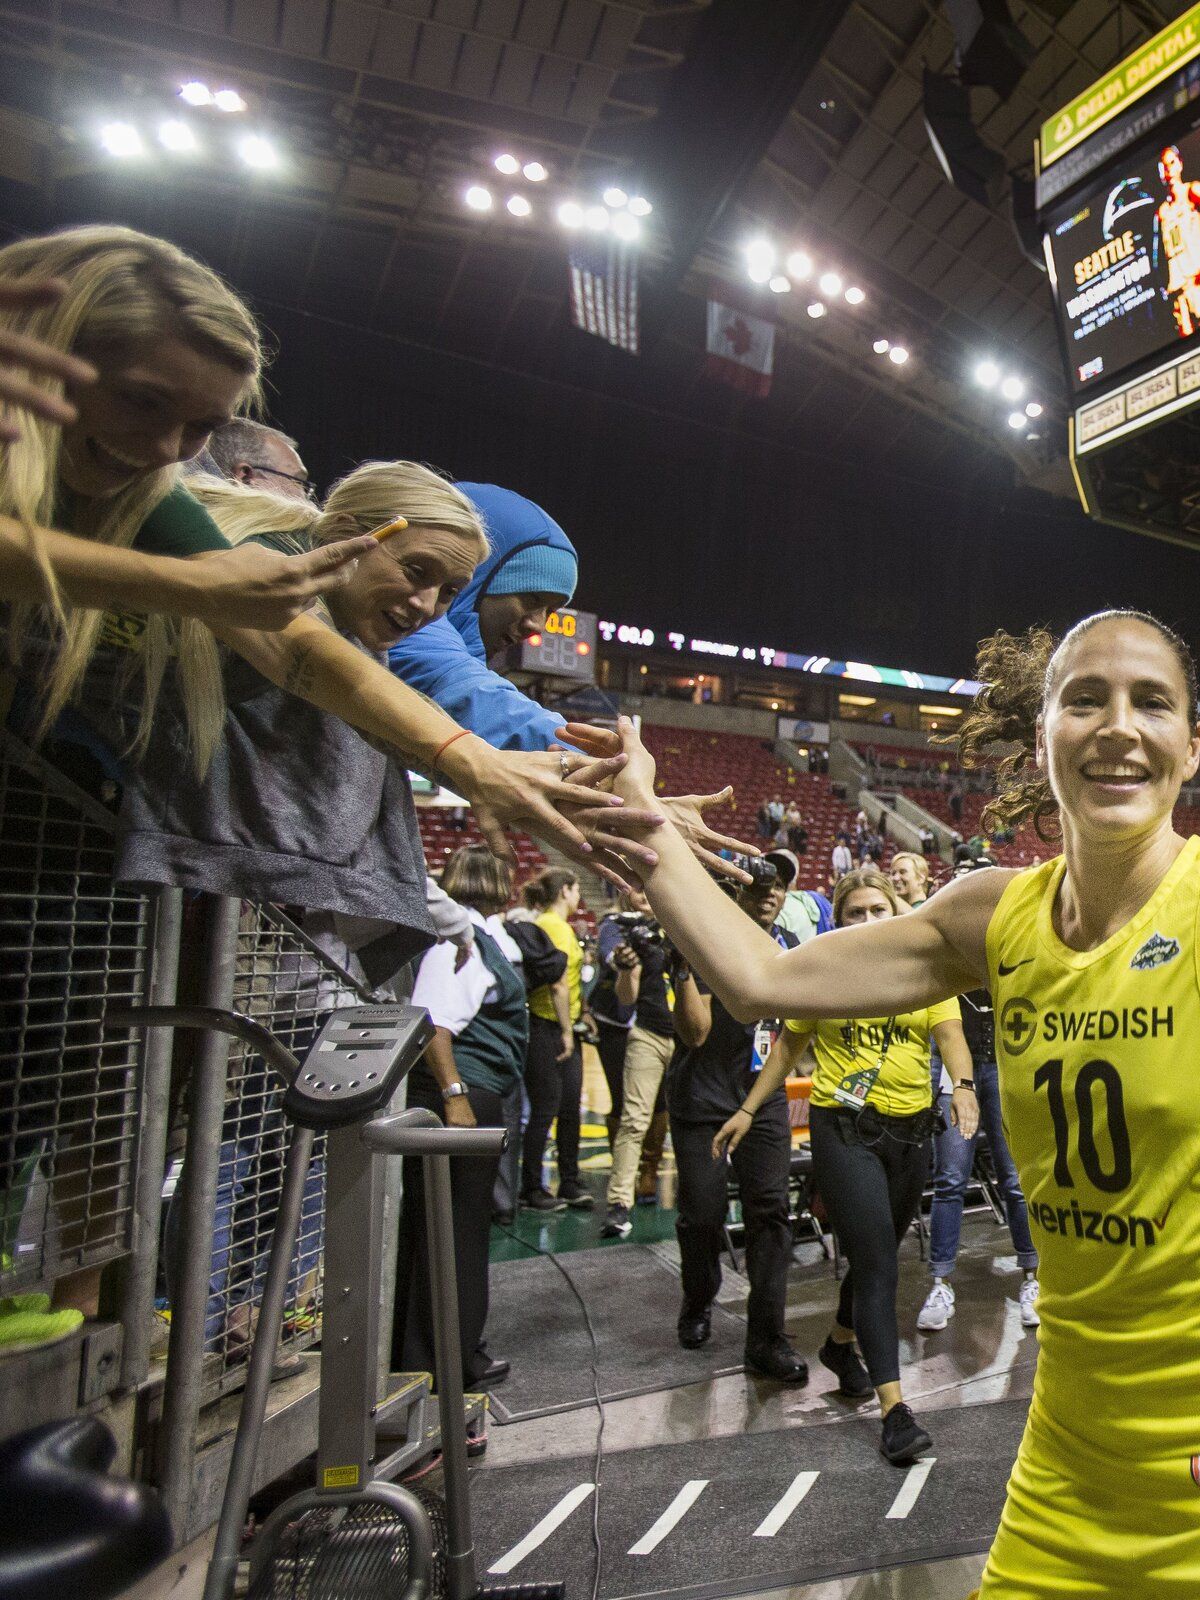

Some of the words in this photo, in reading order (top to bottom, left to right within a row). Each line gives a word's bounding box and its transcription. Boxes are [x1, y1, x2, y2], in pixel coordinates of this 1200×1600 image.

[1075, 77, 1125, 127] DELTA
[1124, 24, 1196, 89] DENTAL
[1073, 230, 1135, 285] SEATTLE
[1042, 1006, 1174, 1041] SWEDISH
[1034, 1059, 1133, 1193] 10
[1032, 1201, 1156, 1247] verizon
